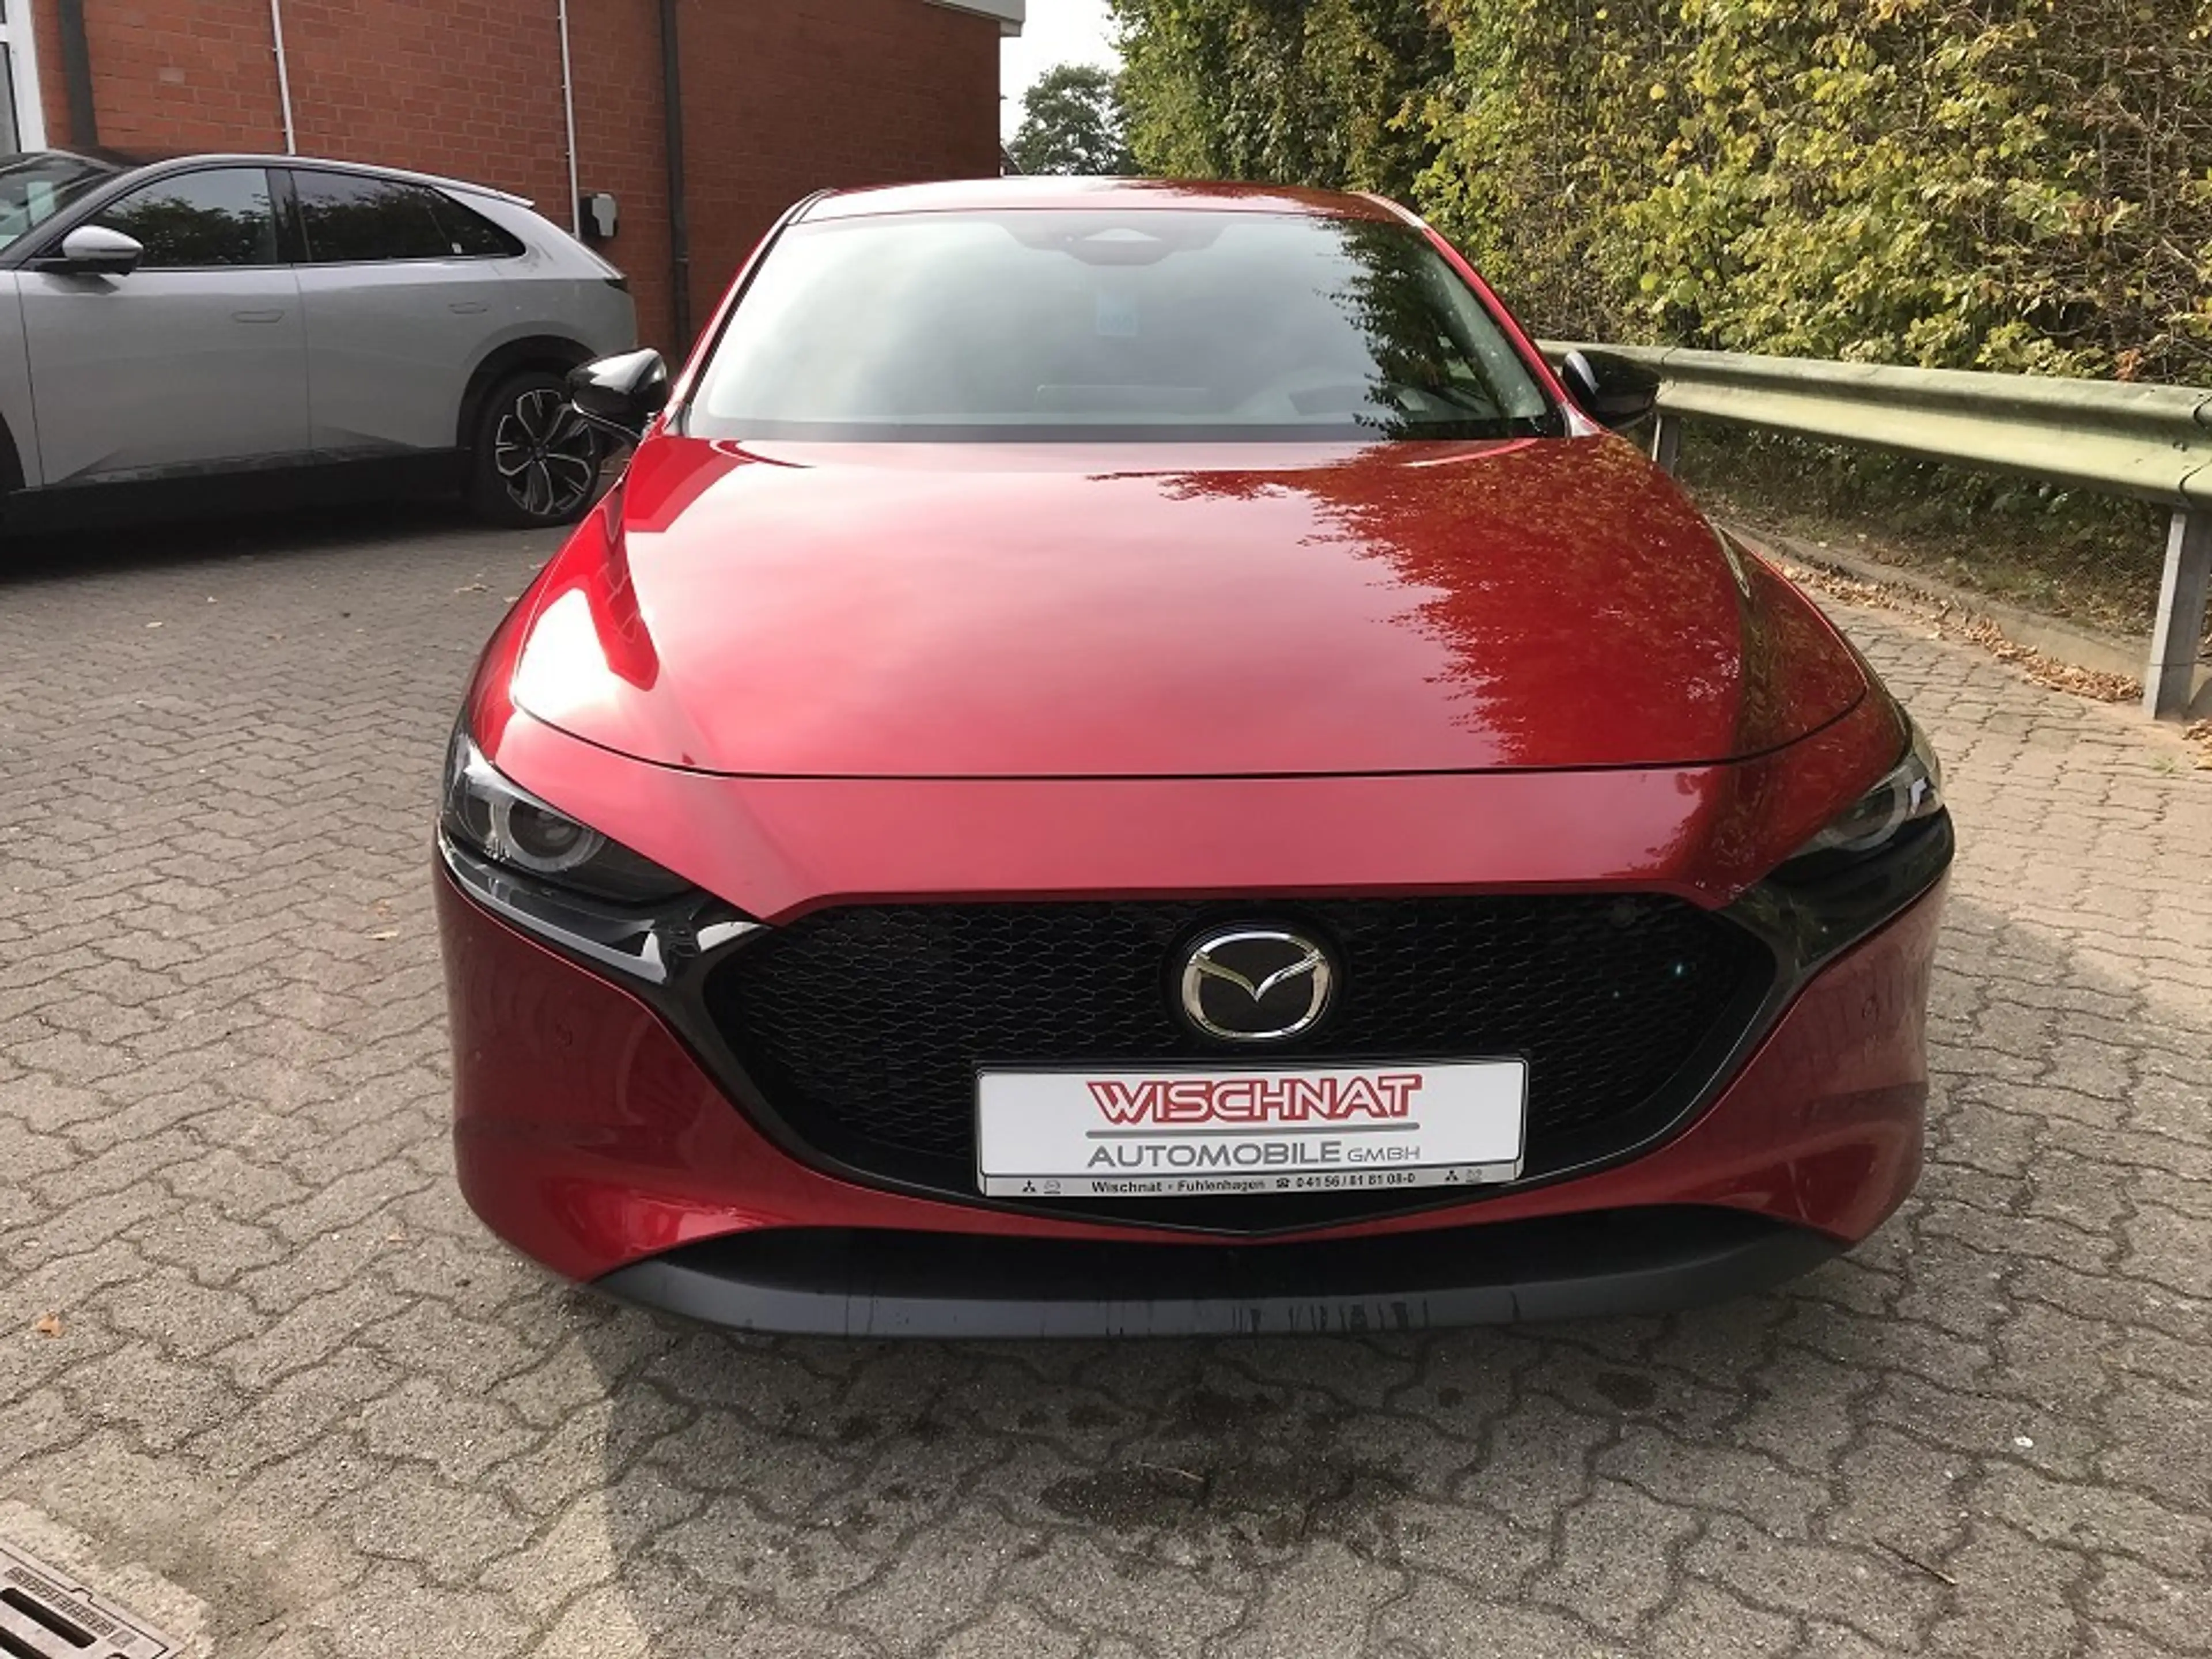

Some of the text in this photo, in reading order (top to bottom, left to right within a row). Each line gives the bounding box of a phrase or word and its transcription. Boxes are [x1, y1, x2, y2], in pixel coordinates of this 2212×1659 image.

[1086, 1074, 1422, 1125] WISCHNAT
[1087, 1141, 1421, 1167] AUTOMOBILE GMBH
[1091, 1180, 1162, 1194] Wischnat
[1177, 1180, 1266, 1192] Fuhlenhagen
